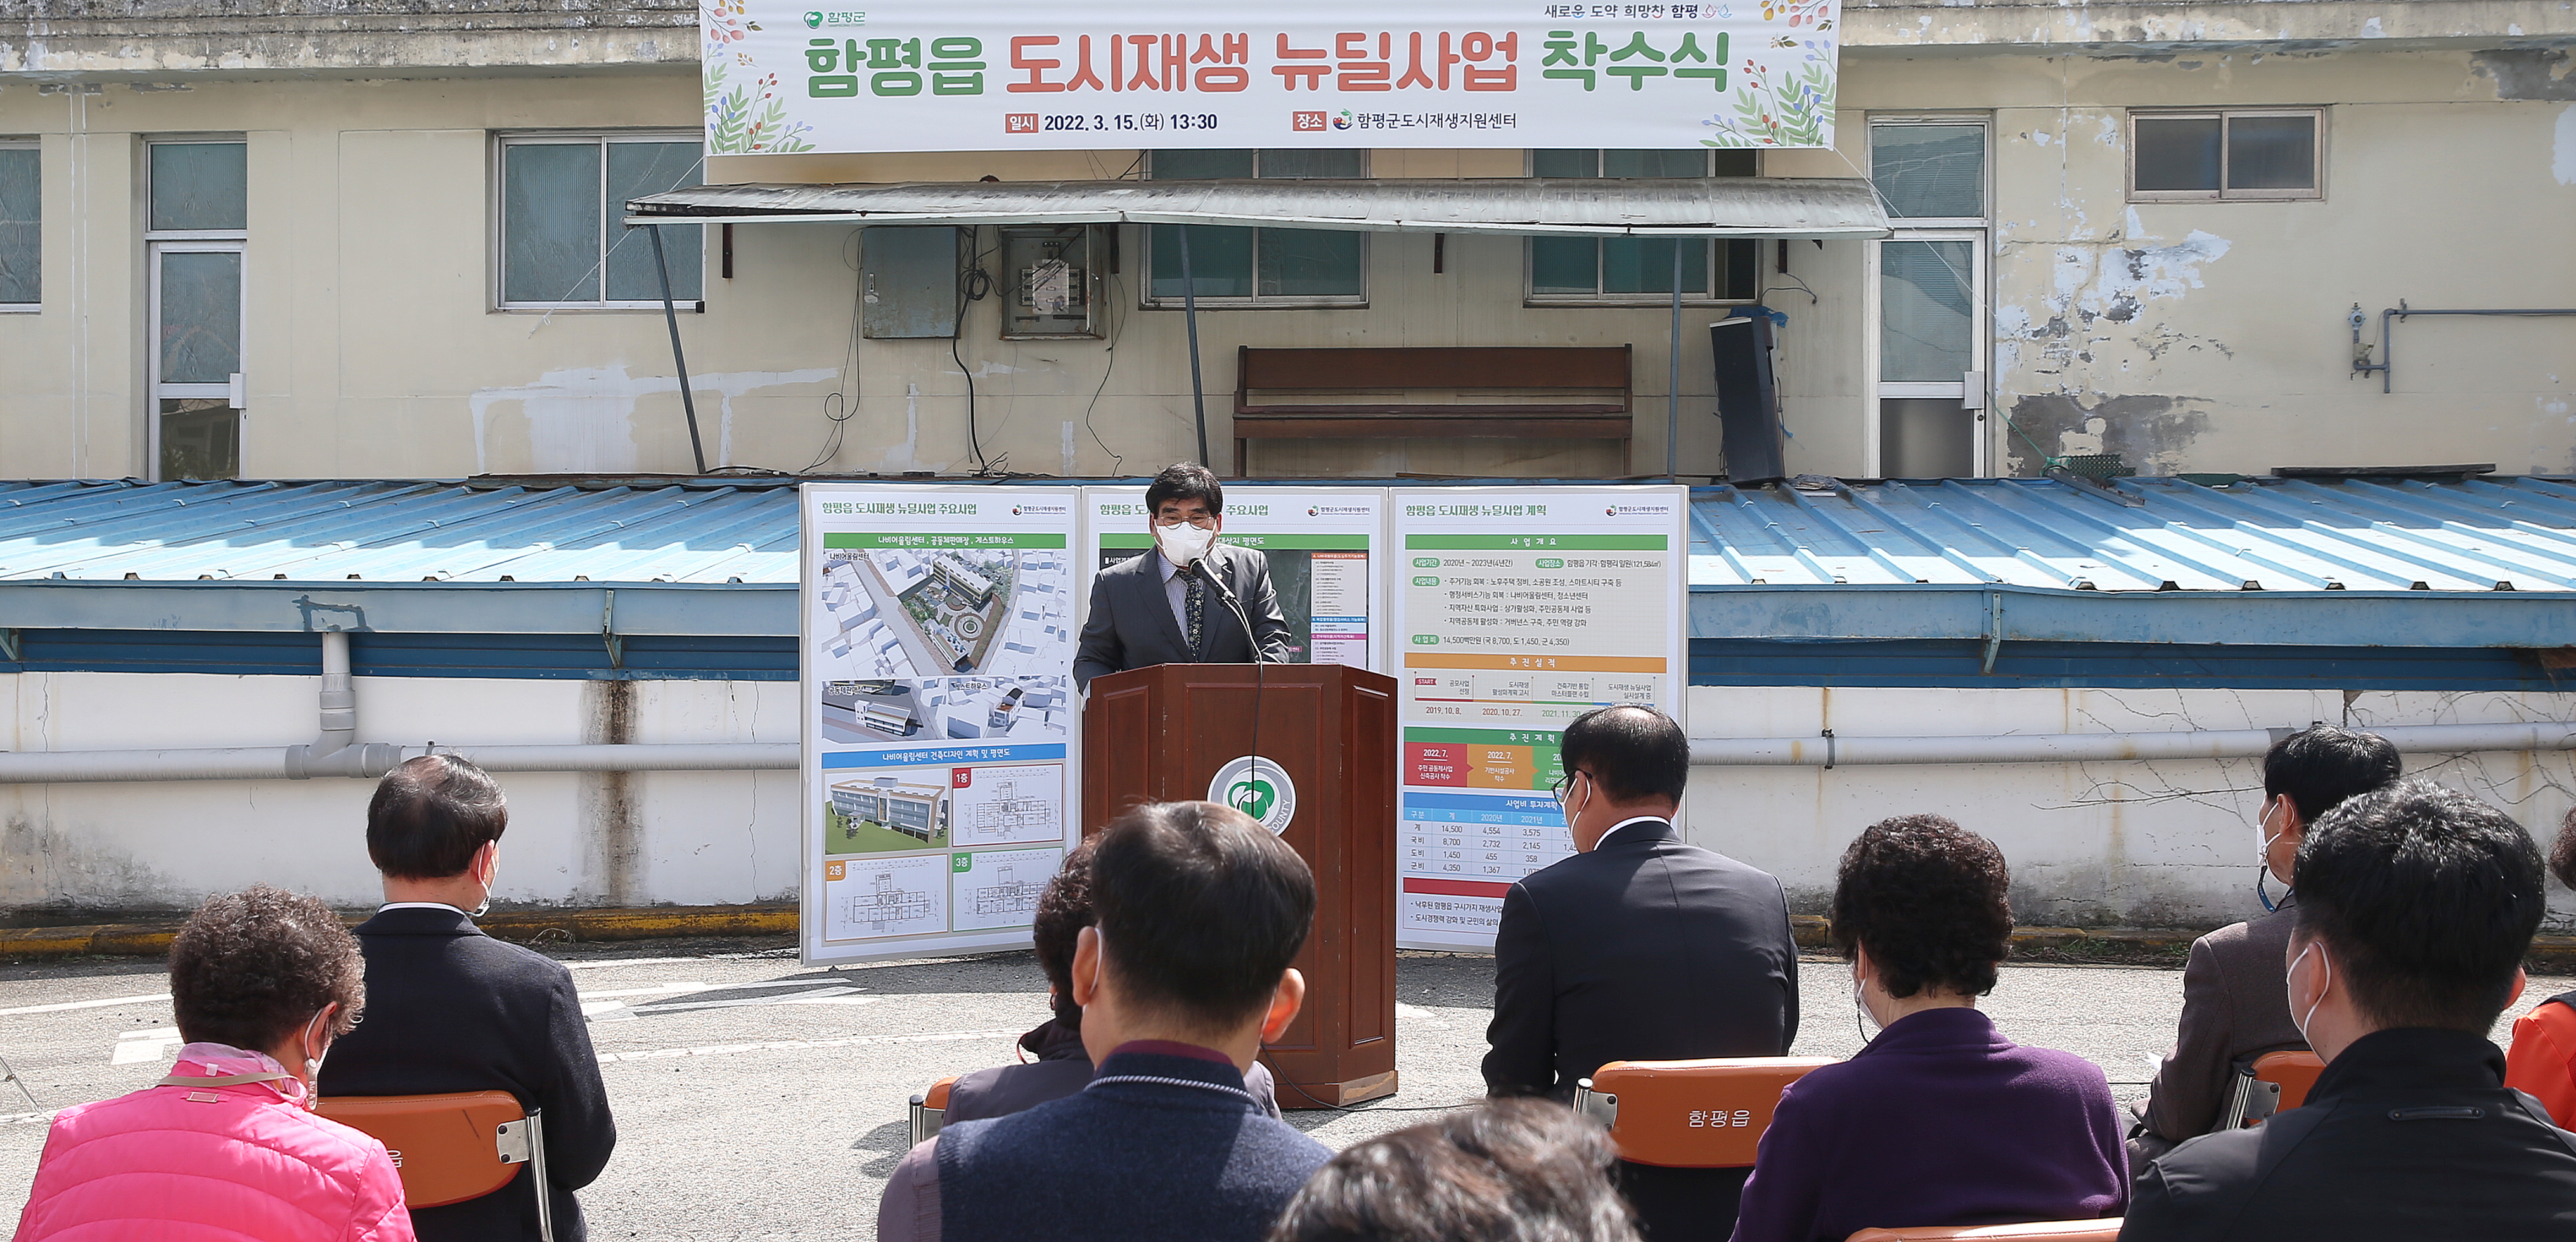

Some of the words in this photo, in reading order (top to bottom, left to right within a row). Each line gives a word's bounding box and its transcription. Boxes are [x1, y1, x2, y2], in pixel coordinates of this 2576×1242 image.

[1544, 4, 1585, 18] 새로운
[1590, 4, 1618, 18] 도약
[1625, 4, 1665, 18] 희망찬
[1671, 4, 1698, 18] 함평
[828, 12, 865, 22] 함평군
[804, 36, 986, 99] 함평읍
[1006, 32, 1250, 94] 도시재생
[1271, 30, 1518, 93] 뉴딜사업
[1541, 30, 1729, 93] 착수식
[1009, 115, 1034, 131] 일시
[1045, 115, 1088, 131] 2022.
[1093, 115, 1109, 131] 3.
[1171, 113, 1218, 130] 13:30
[1297, 113, 1323, 130] 장소
[1357, 112, 1516, 130] 함평군도시재생지원센터
[823, 502, 852, 514] 함평읍
[856, 503, 895, 514] 도시재생
[898, 503, 936, 514] 뉴딜사업
[939, 503, 977, 515] 주요사업
[1100, 504, 1131, 515] 함평읍
[1226, 505, 1268, 515] 주요사업
[1406, 505, 1436, 516] 함평읍
[1439, 505, 1478, 516] 도시재생
[1481, 505, 1523, 516] 뉴딜사업
[1526, 505, 1547, 516] 계획
[878, 536, 925, 546] 나비어울림센터
[931, 536, 969, 546] 공동체판매장
[1242, 537, 1265, 546] 평면도
[830, 552, 870, 562] 나비어울림센터
[1552, 579, 1567, 587] 조성,
[1449, 591, 1490, 599] 행정서비스기능
[1492, 591, 1504, 599] 회복
[1510, 592, 1556, 600] 나비어울림센터,
[1448, 604, 1473, 612] 지역자산
[1474, 604, 1498, 612] 특화사업
[1505, 605, 1537, 613] 상가활성화,
[1538, 605, 1569, 613] 주민공동체
[1585, 605, 1591, 614] 등
[1480, 618, 1498, 626] 활성화
[1560, 619, 1573, 627] 역량
[1575, 619, 1587, 627] 강화
[1443, 637, 1481, 645] 14,500백만원
[1483, 637, 1491, 645] (국
[1492, 637, 1512, 645] 8,700,
[1521, 638, 1540, 646] 1,450,
[1542, 638, 1549, 646] 군
[882, 751, 928, 762] 나비어울림센터
[931, 751, 963, 760] 건축디자인
[965, 749, 979, 759] 계획
[981, 749, 988, 759] 및
[990, 748, 1010, 758] 평면도
[1424, 749, 1441, 757] 2022.
[1442, 749, 1448, 758] 7.
[1487, 751, 1505, 760] 2022.
[1484, 767, 1515, 775] 기반시설공사
[956, 773, 969, 784] 1층
[1530, 801, 1558, 810] 투자계획
[1481, 813, 1503, 822] 2020년
[1521, 815, 1543, 824] 2021년
[1441, 825, 1463, 834] 14,500
[1483, 827, 1500, 836] 4,554
[1523, 829, 1541, 838] 3,575
[1410, 836, 1424, 844] 국비
[1443, 838, 1460, 846] 8,700
[1483, 840, 1500, 848] 2,732
[1523, 842, 1541, 850] 2,145
[1410, 848, 1424, 857] 도비
[1443, 851, 1460, 860] 1,450
[1485, 853, 1497, 861] 455
[955, 857, 968, 867] 3층
[1410, 862, 1424, 870] 군비
[829, 865, 842, 876] 2층
[1443, 864, 1460, 872] 4,350
[1483, 865, 1500, 874] 1,367
[1415, 900, 1433, 909] 낙후된
[1434, 902, 1452, 910] 함평읍
[1454, 903, 1478, 912] 구시가지
[1415, 914, 1445, 923] 도시경쟁력
[1446, 915, 1458, 924] 강화
[1459, 916, 1465, 924] 및
[1467, 917, 1485, 926] 군민의
[1486, 918, 1498, 926] 삶의
[1688, 1109, 1751, 1129] 함평읍
